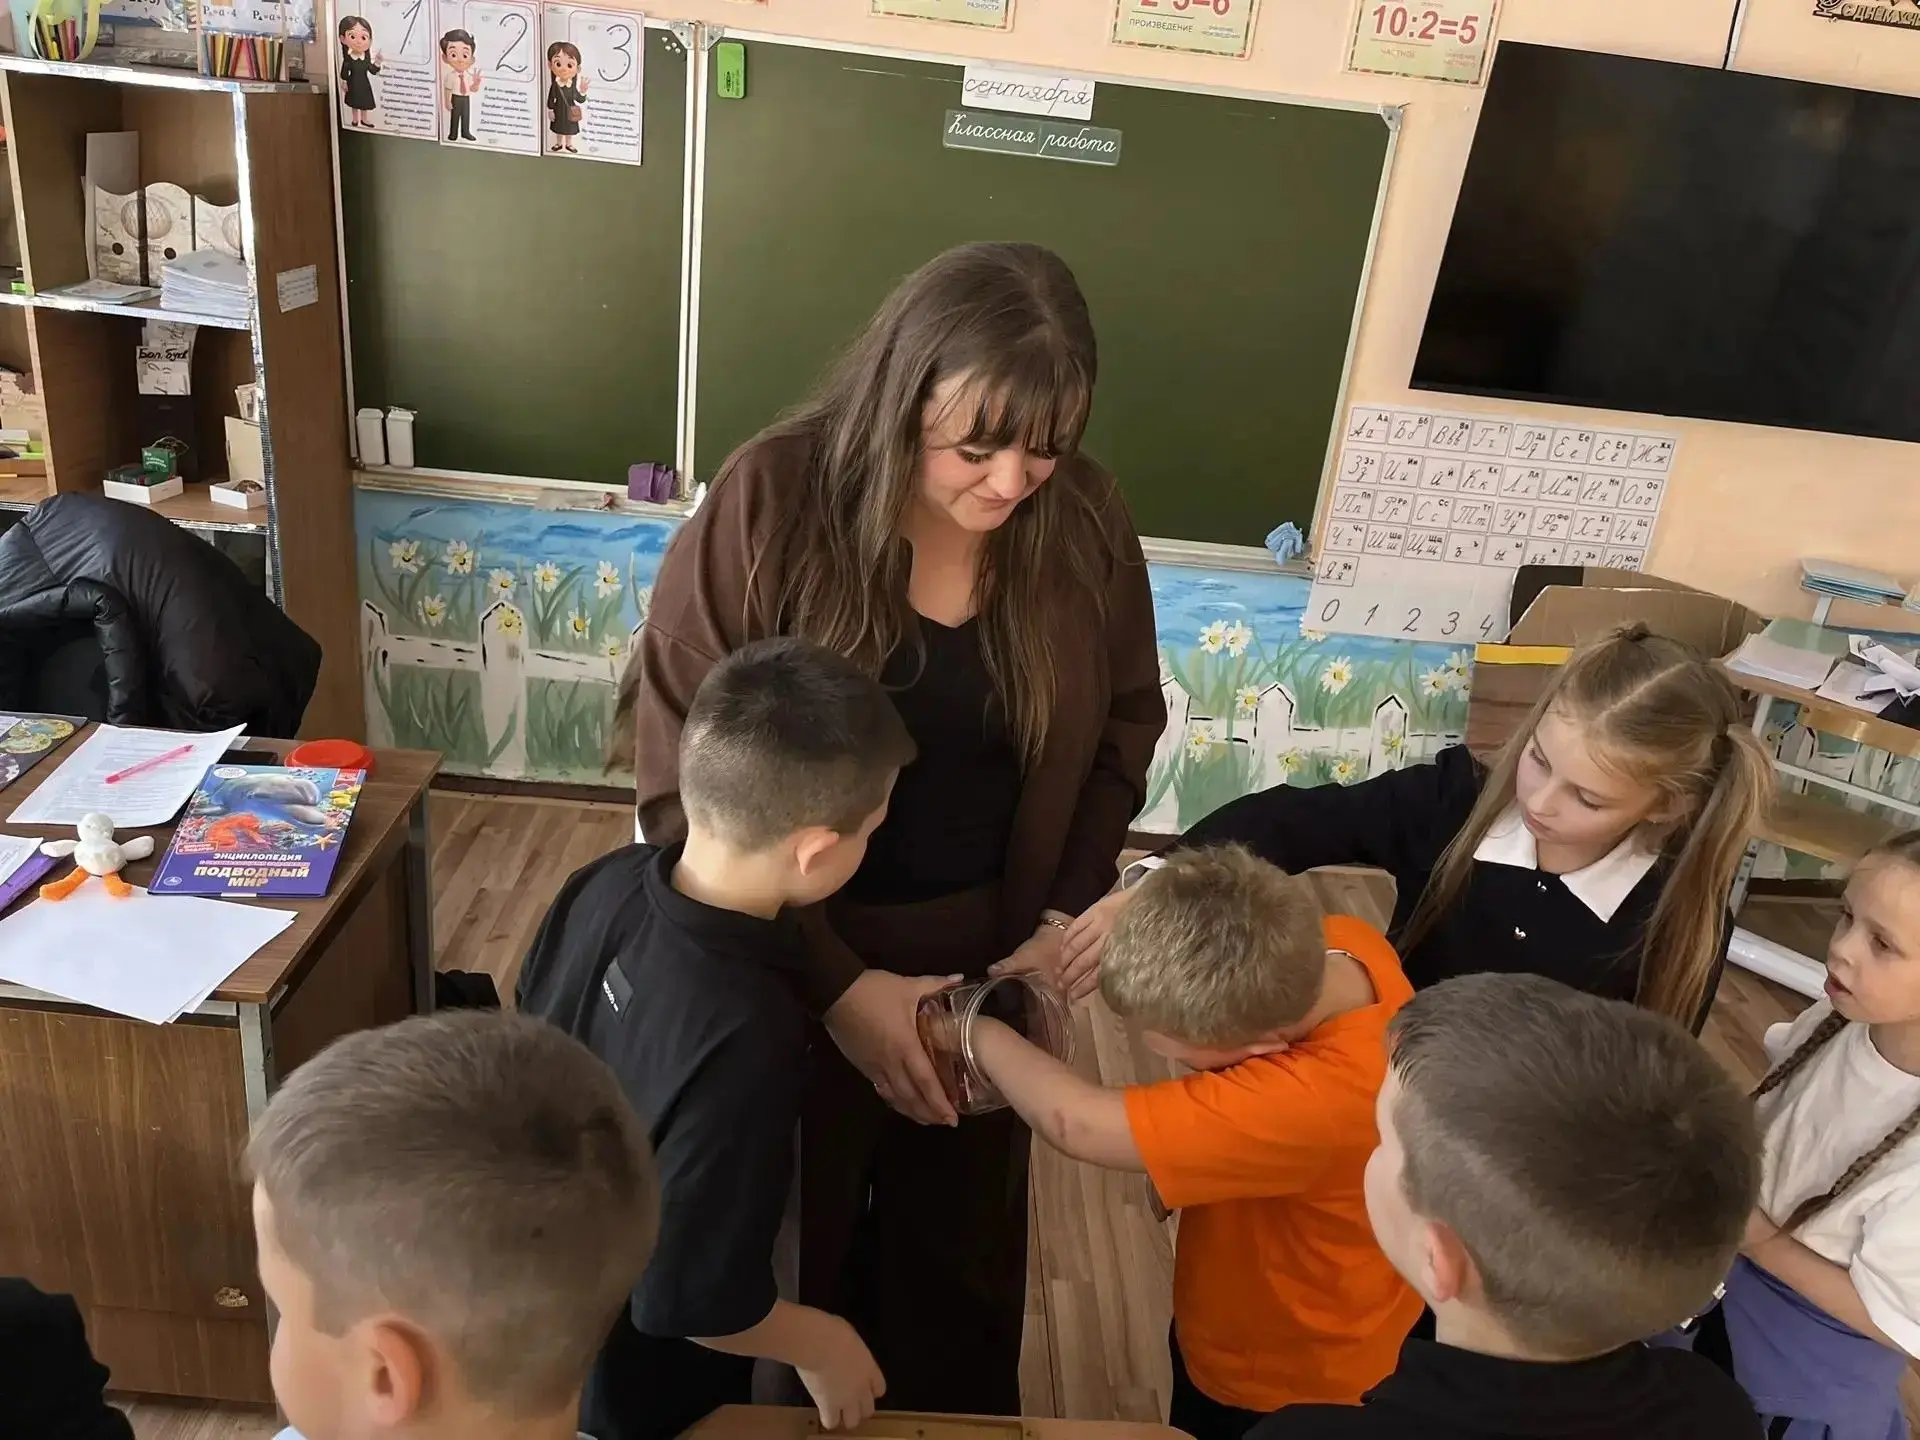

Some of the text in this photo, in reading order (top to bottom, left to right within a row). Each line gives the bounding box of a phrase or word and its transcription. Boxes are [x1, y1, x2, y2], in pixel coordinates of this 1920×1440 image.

[496, 13, 528, 71] 2
[1129, 18, 1194, 32] ПРОИЗВЕДЕНИЕ
[1372, 4, 1479, 45] 10:2=5
[597, 24, 631, 82] 3
[964, 78, 1091, 113] сентября
[948, 113, 1117, 153] Классная работа
[1321, 599, 1494, 638] 0 1 2 3 4
[194, 865, 310, 878] ПОДВОДНЫЙ
[213, 852, 302, 861] ЭНЦИКЛОПЕДИЯ
[228, 877, 269, 887] МИР
